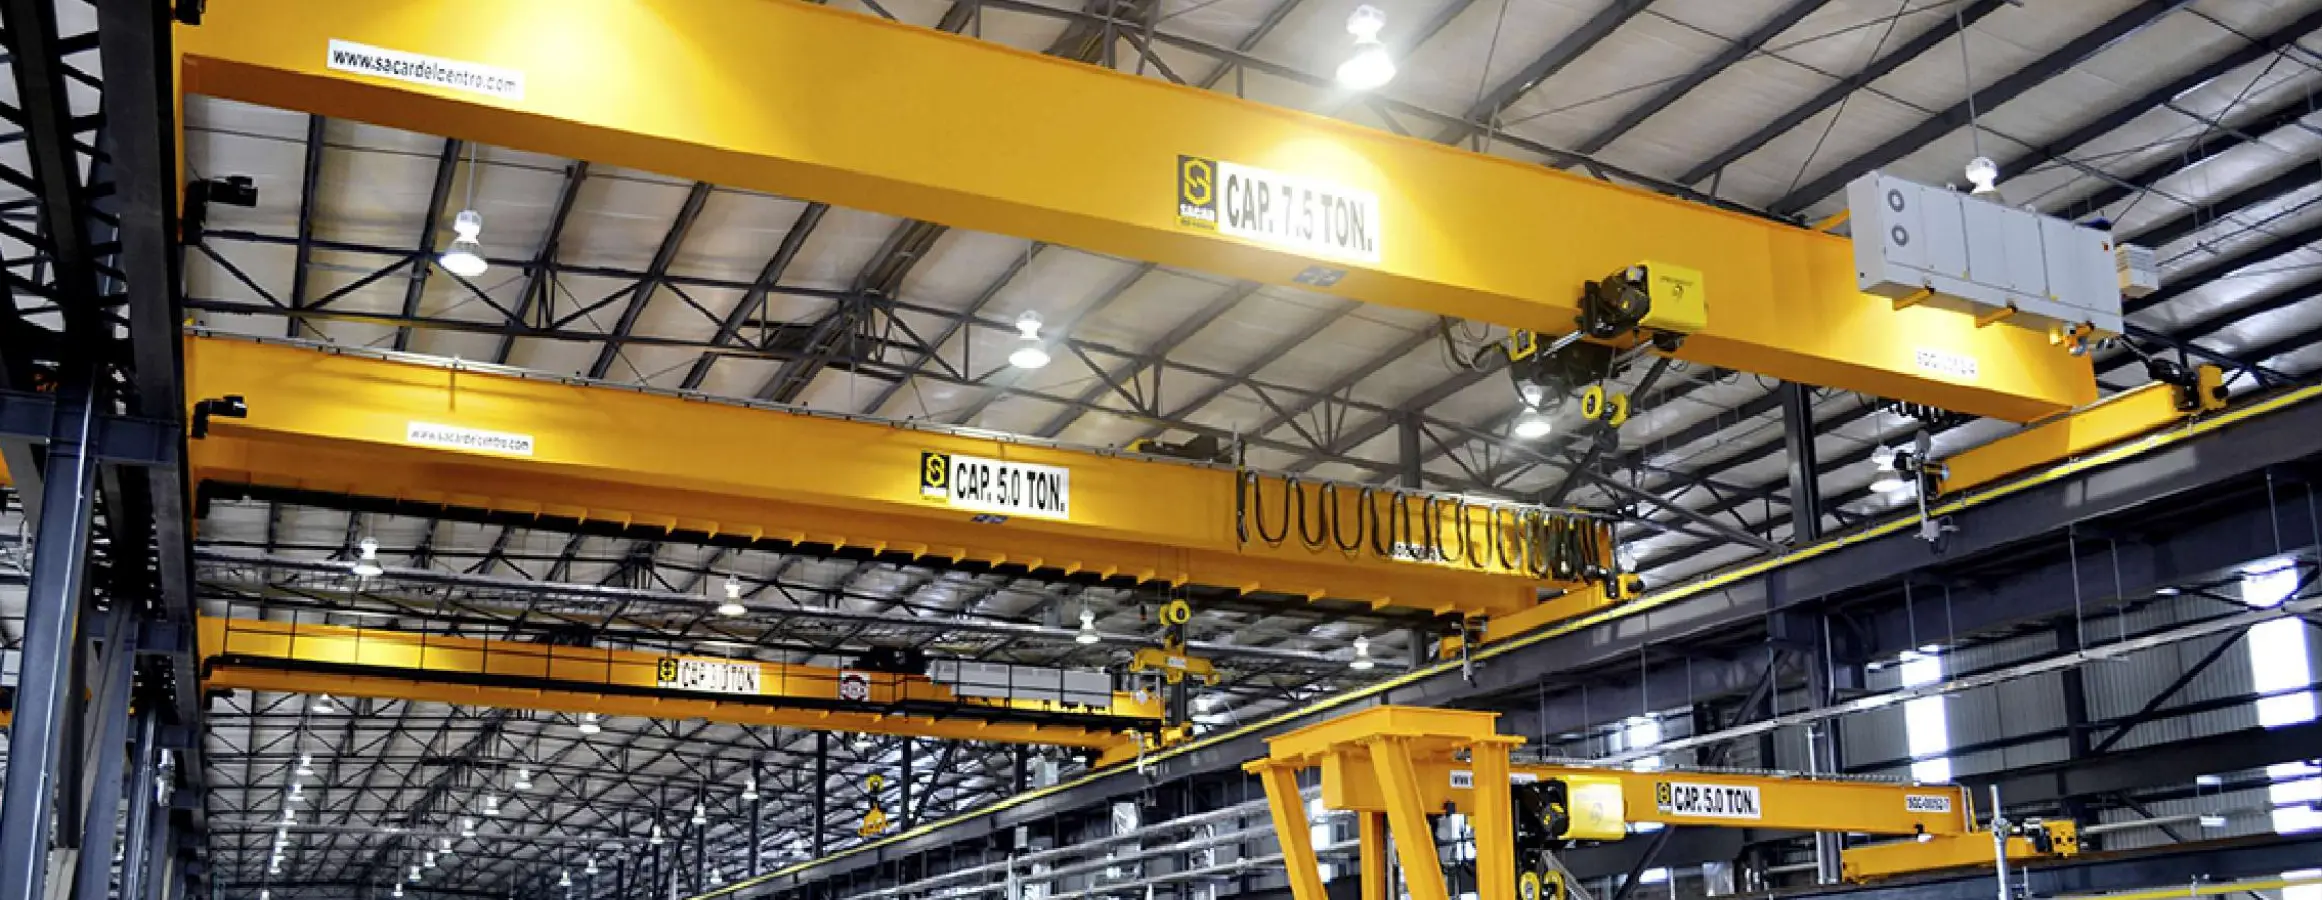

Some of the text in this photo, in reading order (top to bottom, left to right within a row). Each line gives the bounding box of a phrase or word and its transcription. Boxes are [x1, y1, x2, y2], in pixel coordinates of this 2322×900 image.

[333, 49, 517, 94] www.sacardelcentro.com
[1226, 173, 1374, 252] CAP. 7.5 TON.
[956, 462, 1066, 513] CAP. 5.0 TON.
[1674, 786, 1702, 813] CAP.
